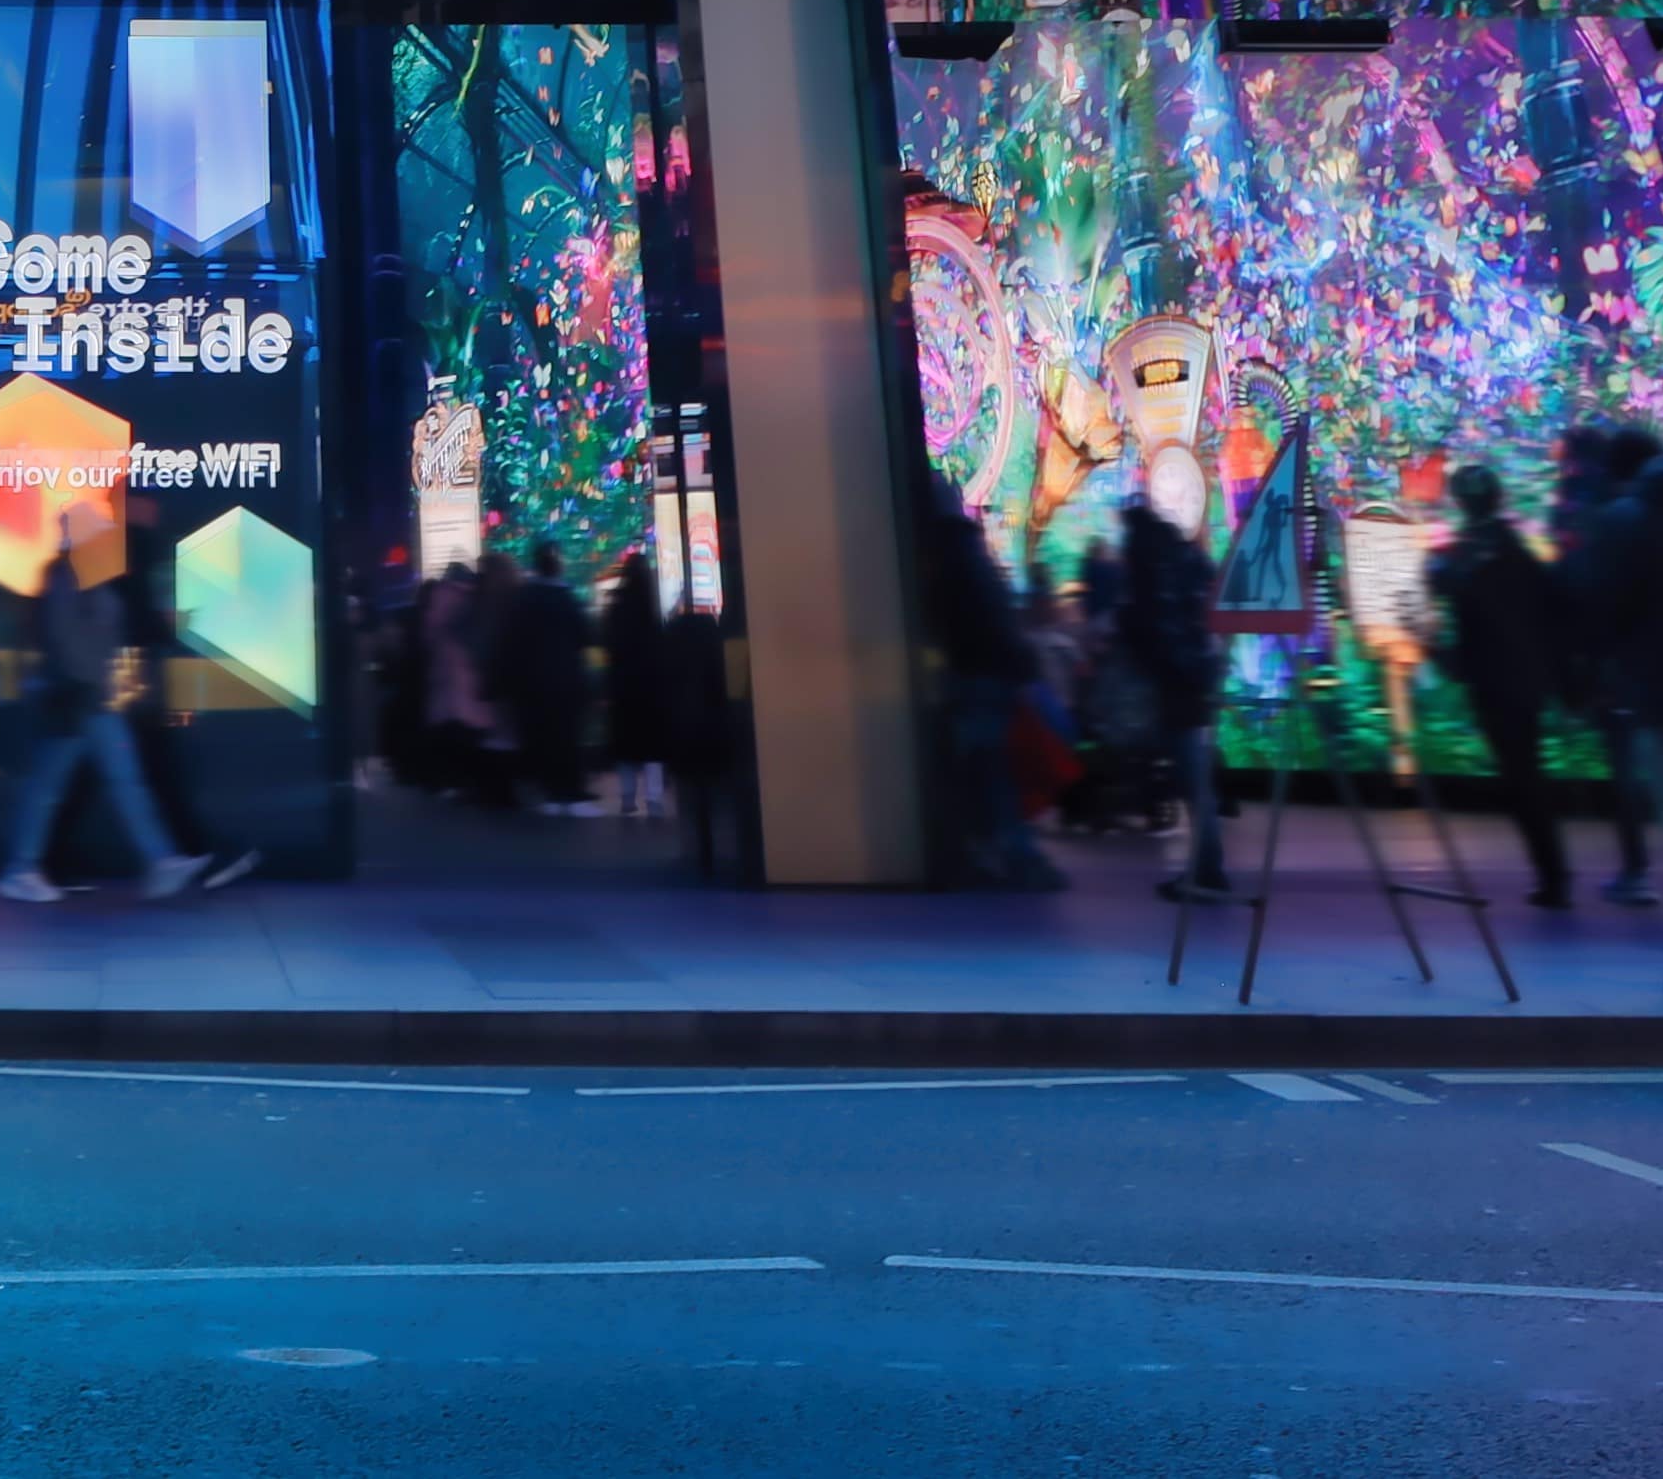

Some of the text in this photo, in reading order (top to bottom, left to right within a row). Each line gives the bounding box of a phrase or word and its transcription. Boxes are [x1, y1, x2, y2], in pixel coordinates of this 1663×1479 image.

[12, 299, 294, 374] Inside
[67, 463, 122, 489] our
[127, 451, 196, 489] free
[199, 451, 279, 489] WIFI
